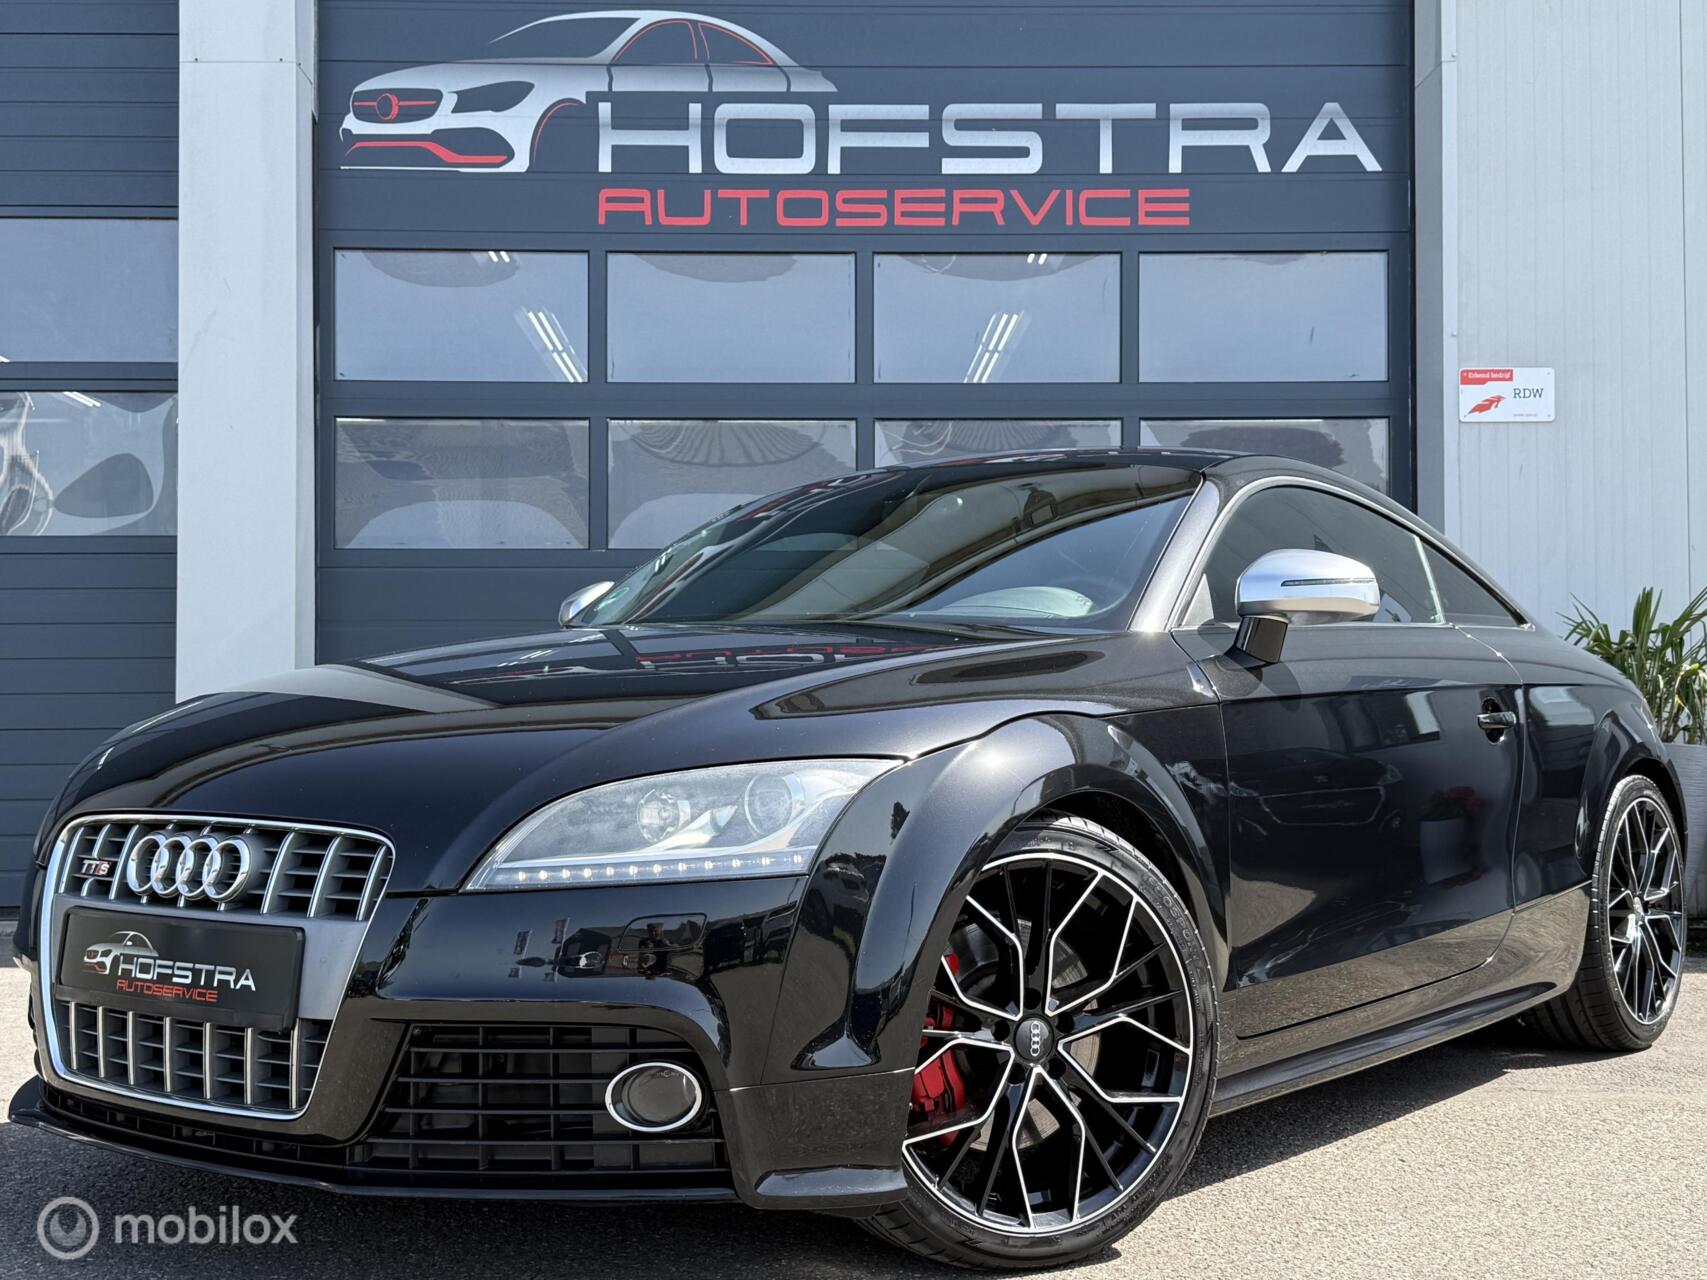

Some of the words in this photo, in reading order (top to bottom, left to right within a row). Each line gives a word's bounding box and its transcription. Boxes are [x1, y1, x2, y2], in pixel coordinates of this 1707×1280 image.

[599, 102, 1382, 175] HOFSTRA
[598, 188, 1190, 228] AUTOSERVICE
[1513, 387, 1544, 399] RDW
[81, 859, 110, 876] TTS
[118, 955, 256, 991] HOFSTRA
[116, 979, 218, 1002] AUTOSERVICE
